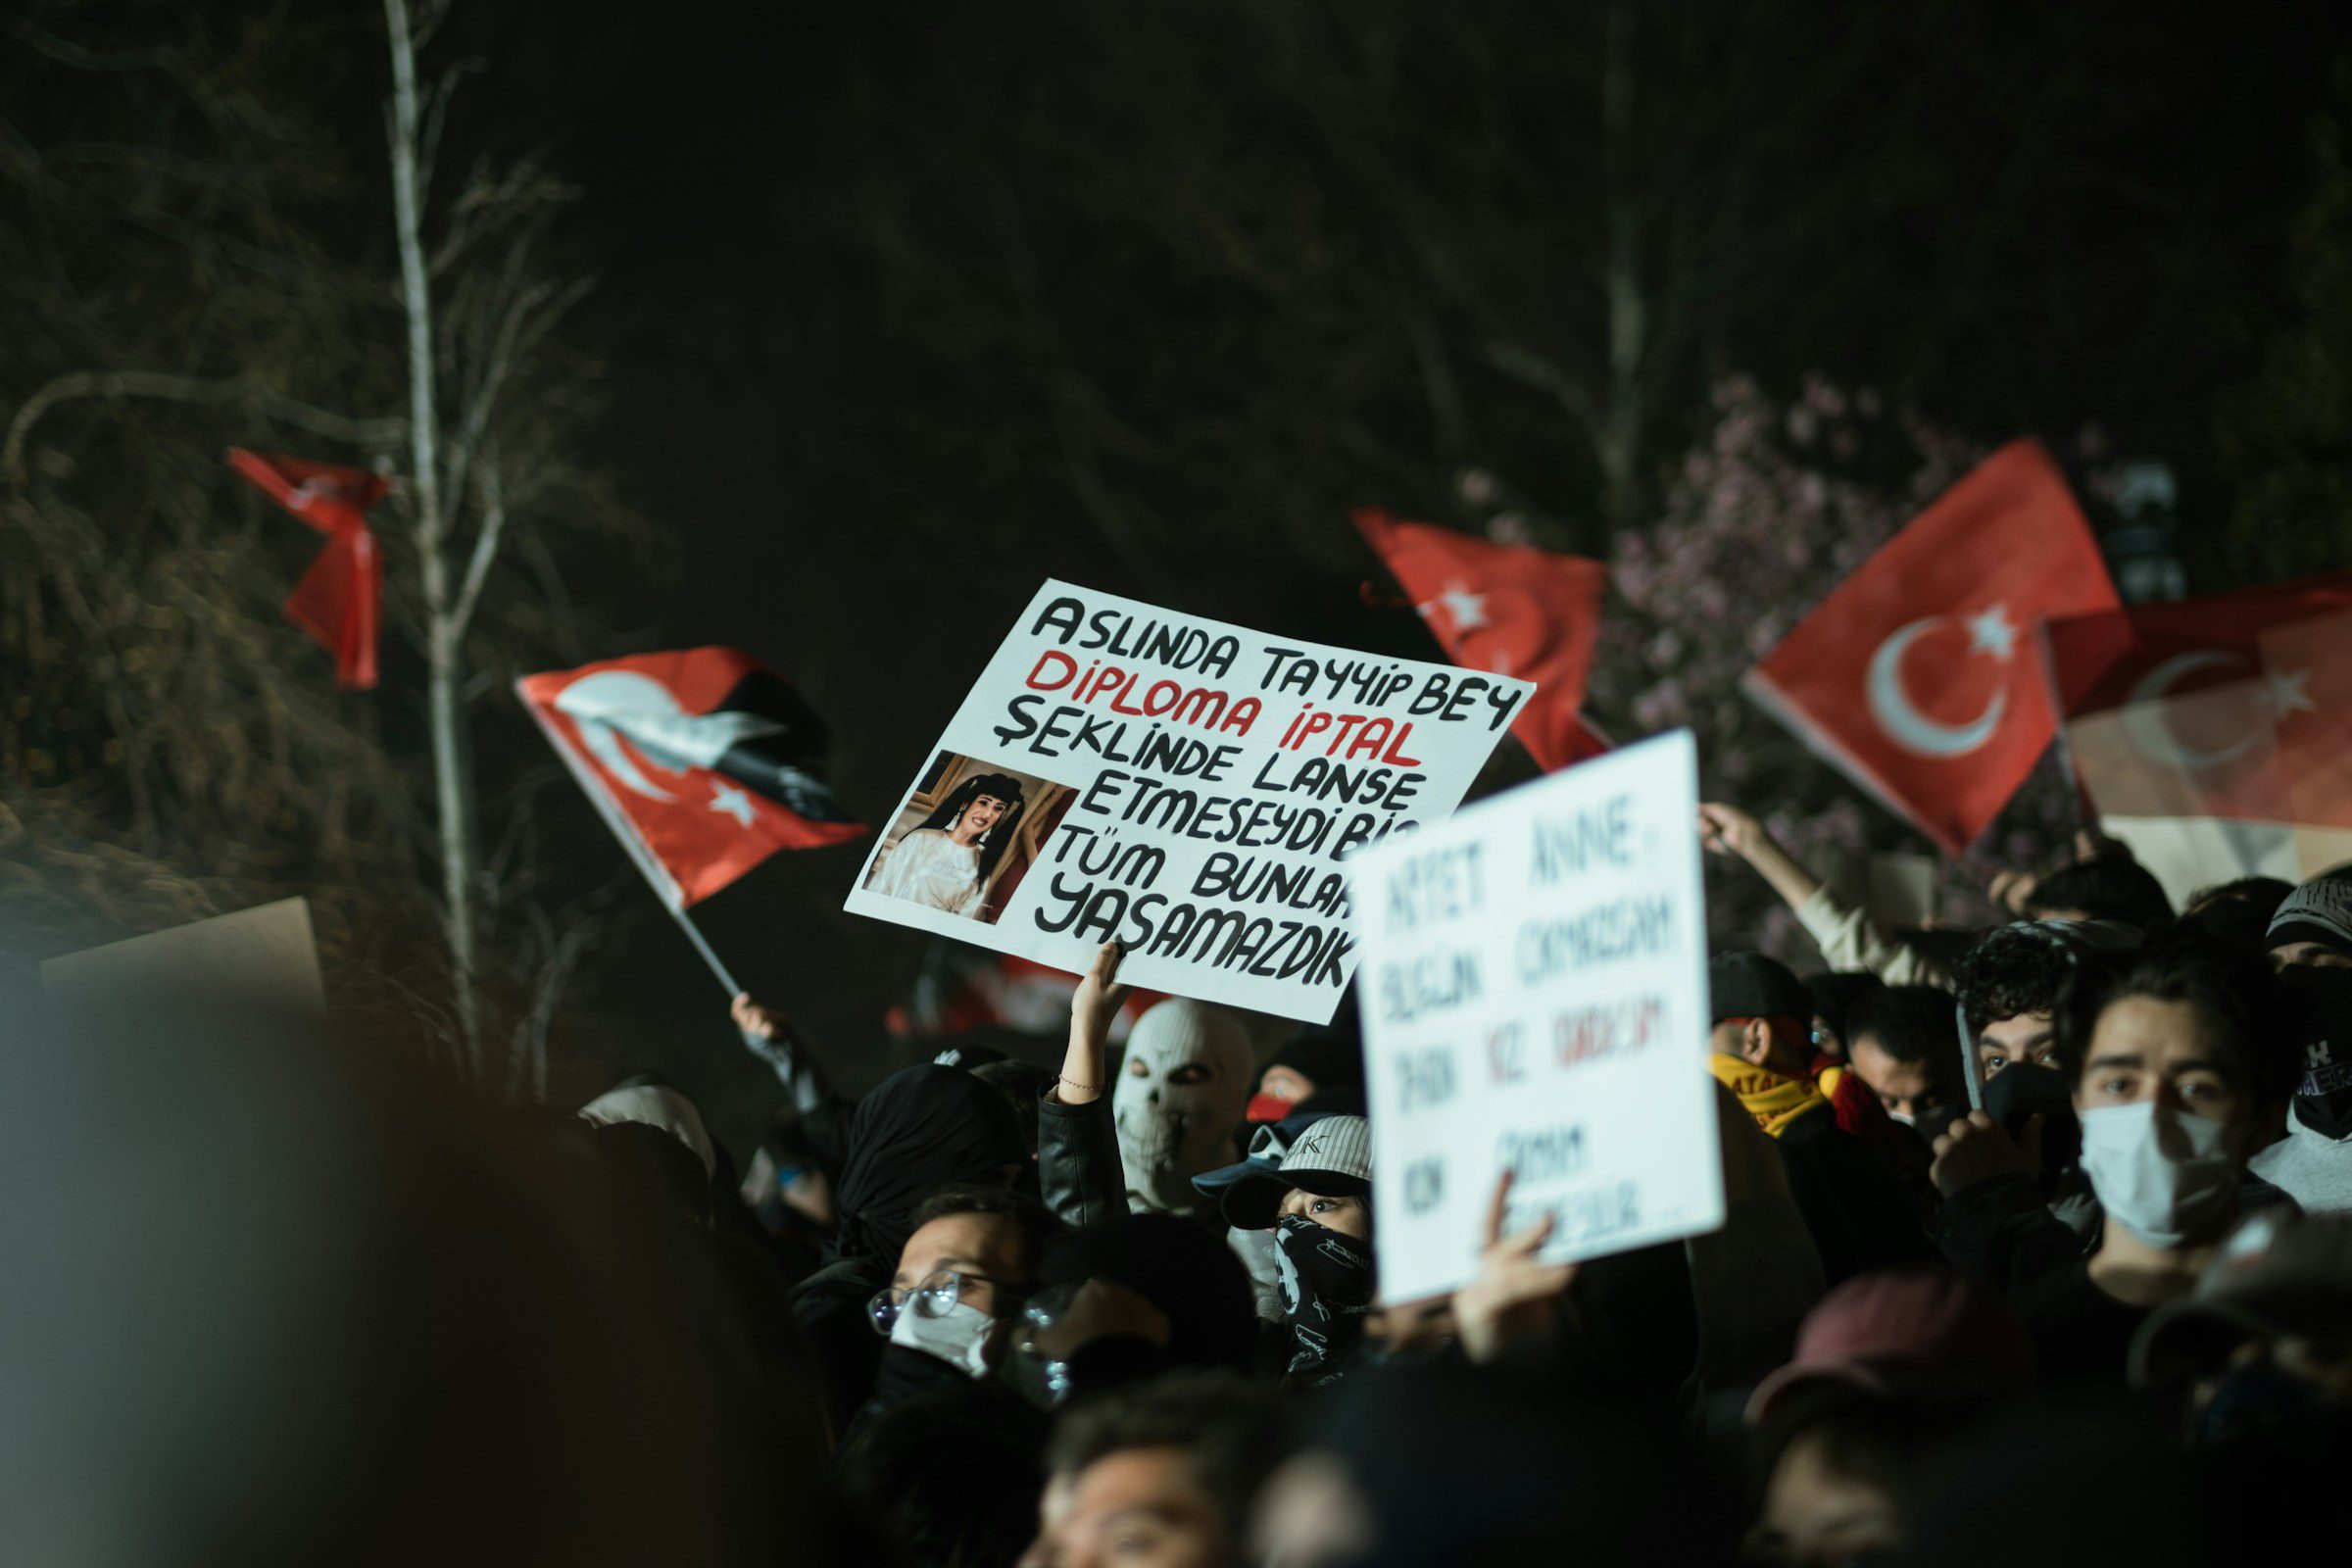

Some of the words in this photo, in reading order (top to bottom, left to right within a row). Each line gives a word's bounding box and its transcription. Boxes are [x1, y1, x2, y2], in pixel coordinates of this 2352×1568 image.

[1026, 650, 1262, 737] DİPLOMA
[1278, 702, 1422, 767] İPTAL
[1030, 597, 1240, 679] ASLINDA
[1260, 647, 1413, 707] TAYYİP
[1407, 672, 1521, 731] BEY
[993, 694, 1244, 782] ŞEKLİNDE
[1251, 752, 1427, 810] LANSE
[1054, 824, 1166, 890] TÜM
[1080, 769, 1344, 855] ETMESEYDİ
